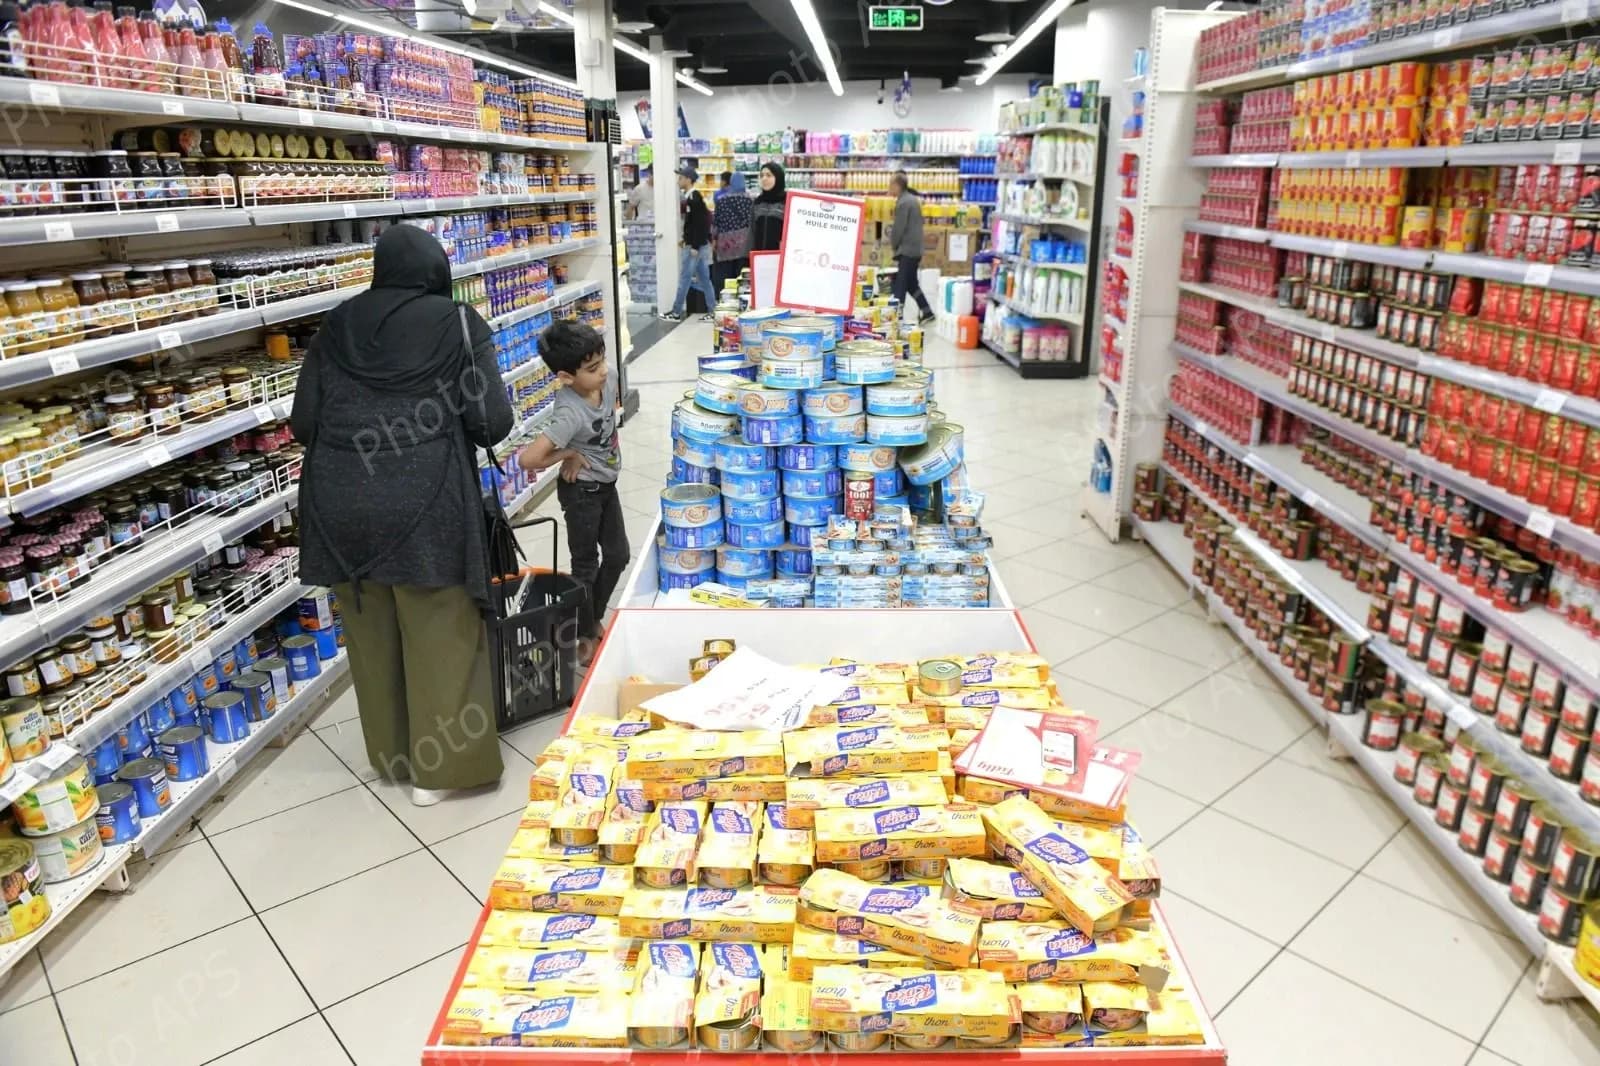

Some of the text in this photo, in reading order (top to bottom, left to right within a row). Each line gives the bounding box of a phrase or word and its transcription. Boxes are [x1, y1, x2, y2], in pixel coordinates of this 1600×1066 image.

[797, 208, 857, 224] POSEIDON THON
[805, 219, 828, 229] HUILE
[946, 912, 977, 926] thon
[892, 929, 915, 942] thon
[923, 1016, 949, 1027] thon
